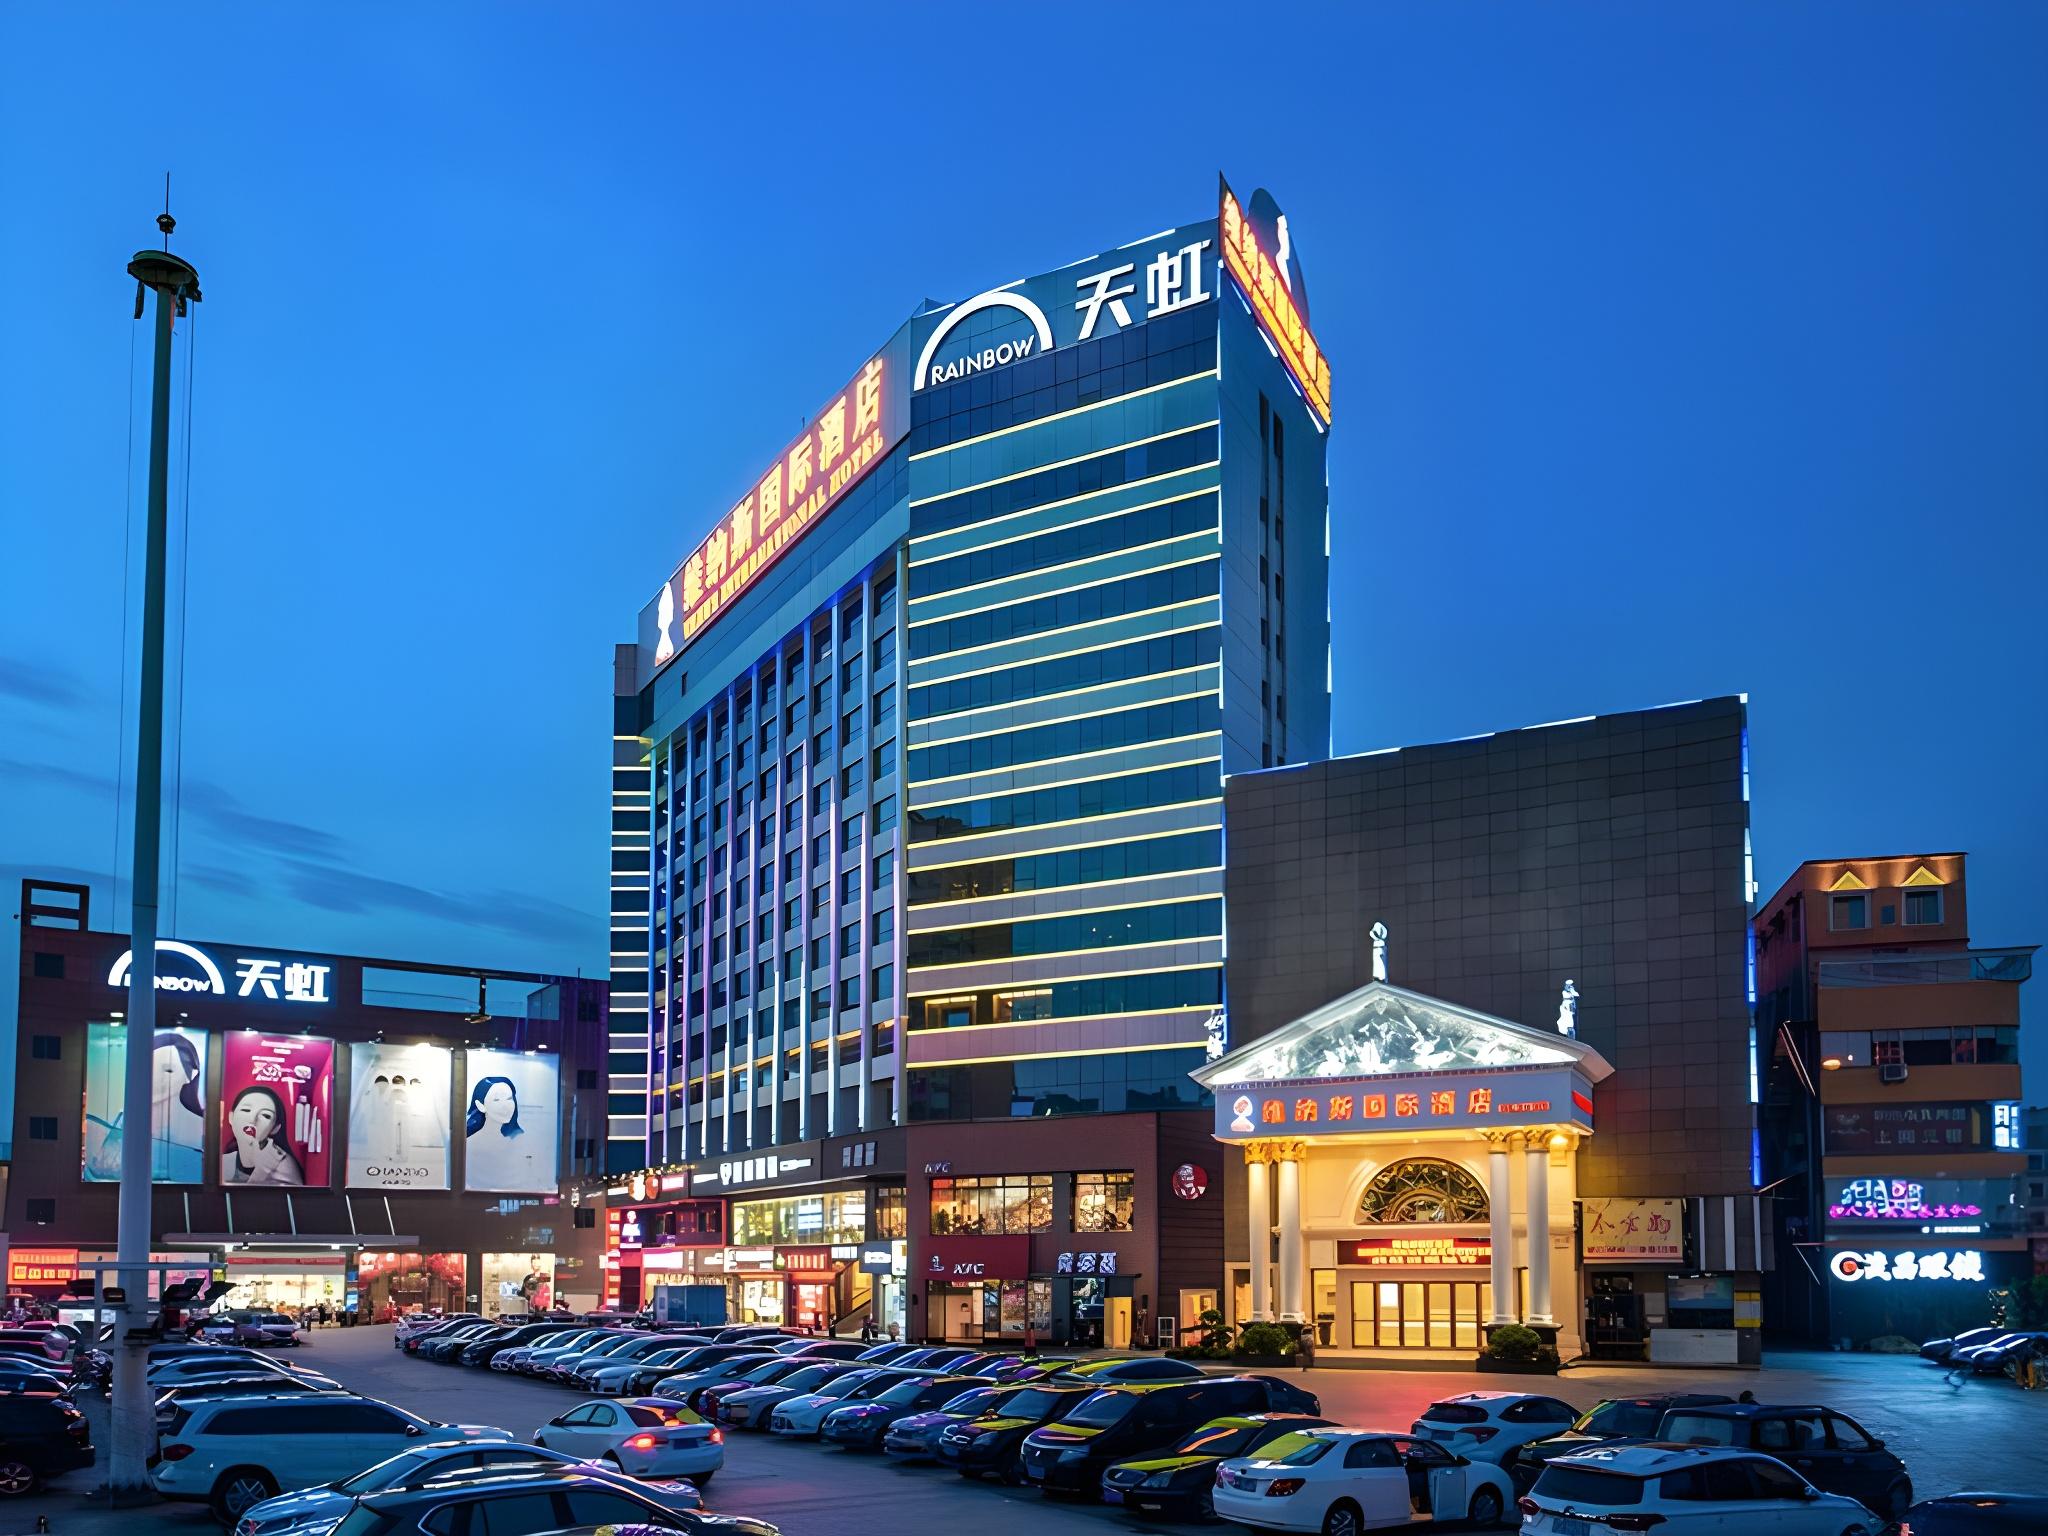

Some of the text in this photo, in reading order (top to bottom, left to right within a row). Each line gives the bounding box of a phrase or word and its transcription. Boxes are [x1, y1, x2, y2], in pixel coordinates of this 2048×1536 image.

[1074, 238, 1212, 341] 天虹
[930, 334, 1036, 386] RAINBOW
[123, 973, 211, 993] NBOW
[235, 958, 331, 1002] 天虹
